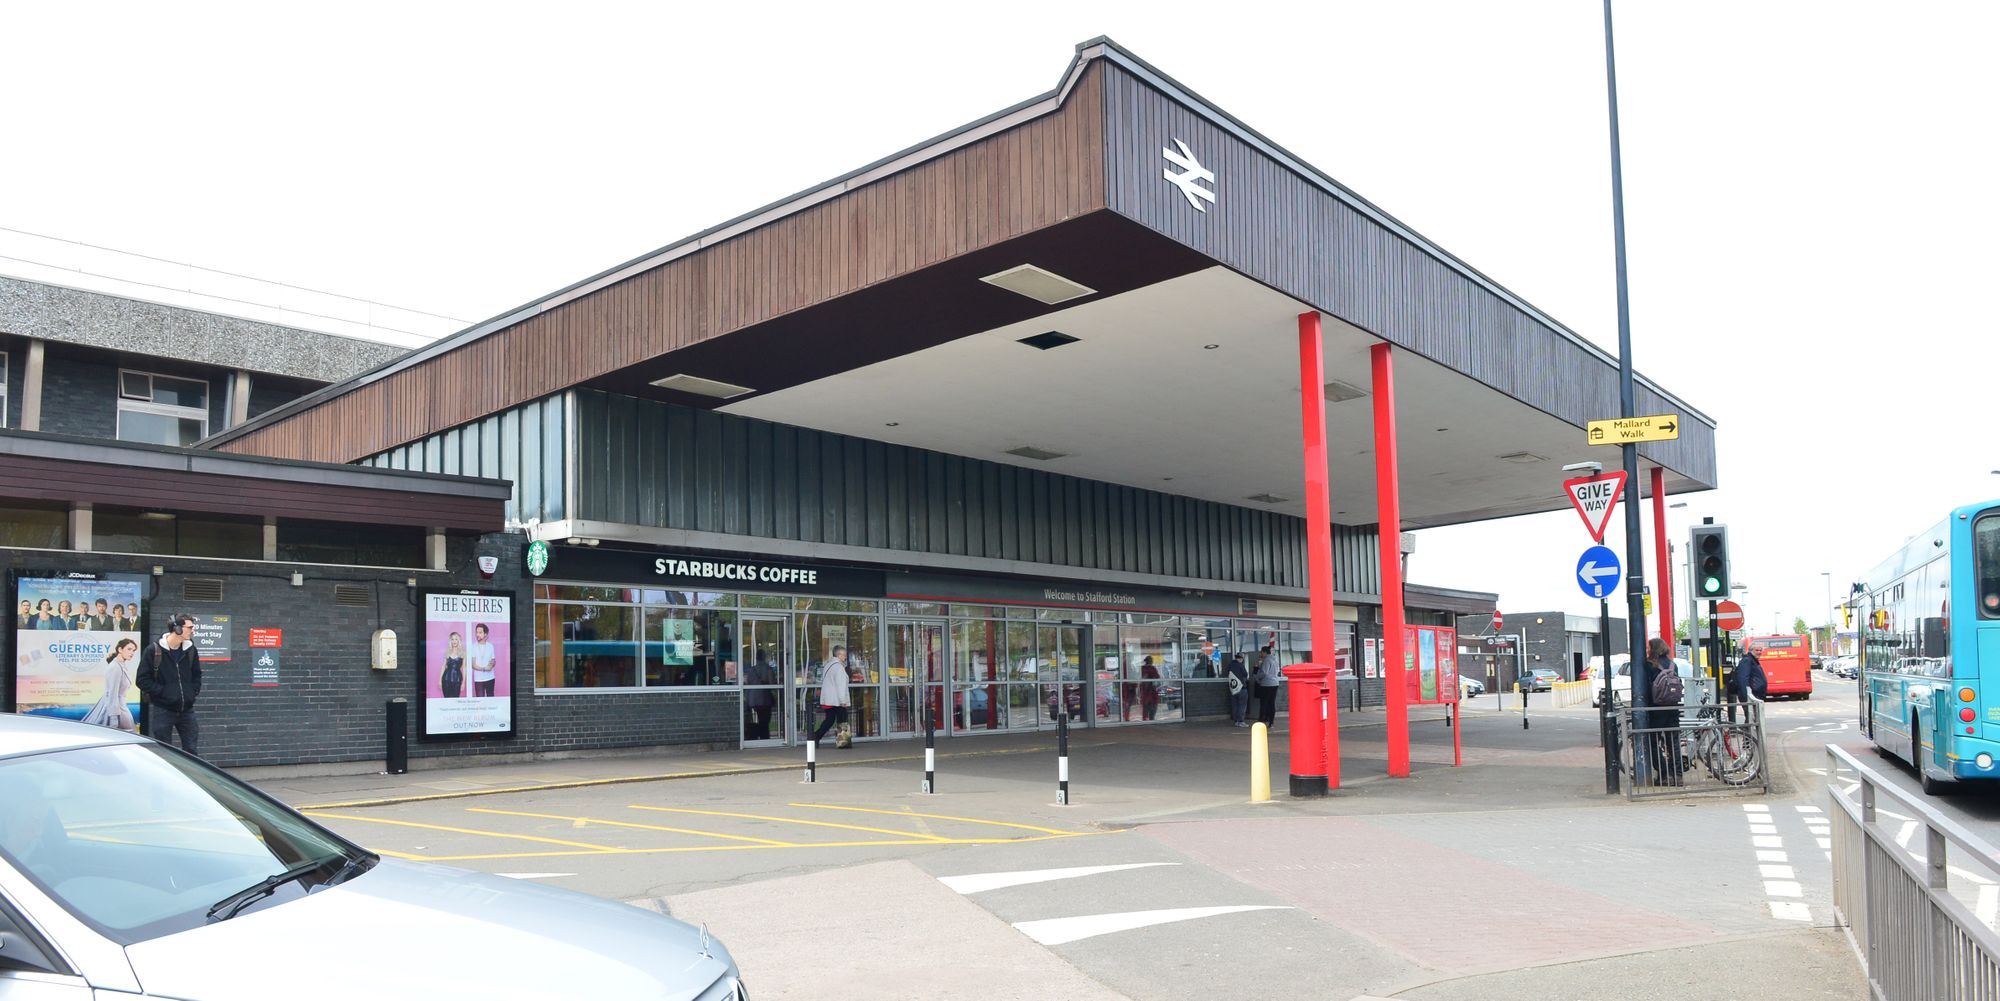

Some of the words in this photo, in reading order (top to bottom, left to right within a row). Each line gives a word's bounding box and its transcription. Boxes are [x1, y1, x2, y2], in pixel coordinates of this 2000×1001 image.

[1613, 419, 1651, 429] Mallard
[1620, 430, 1645, 438] Walk
[1577, 482, 1611, 500] GIVE
[1584, 499, 1608, 512] WAY
[655, 558, 757, 581] STARBUCKS
[759, 566, 817, 585] COFFEE
[1043, 588, 1076, 601] Welcome
[1076, 592, 1085, 601] to
[1085, 591, 1112, 603] Stafford
[1113, 593, 1136, 605] Station
[433, 596, 458, 612] THE
[461, 597, 503, 613] SHIRES
[48, 643, 111, 654] GUERNSEY
